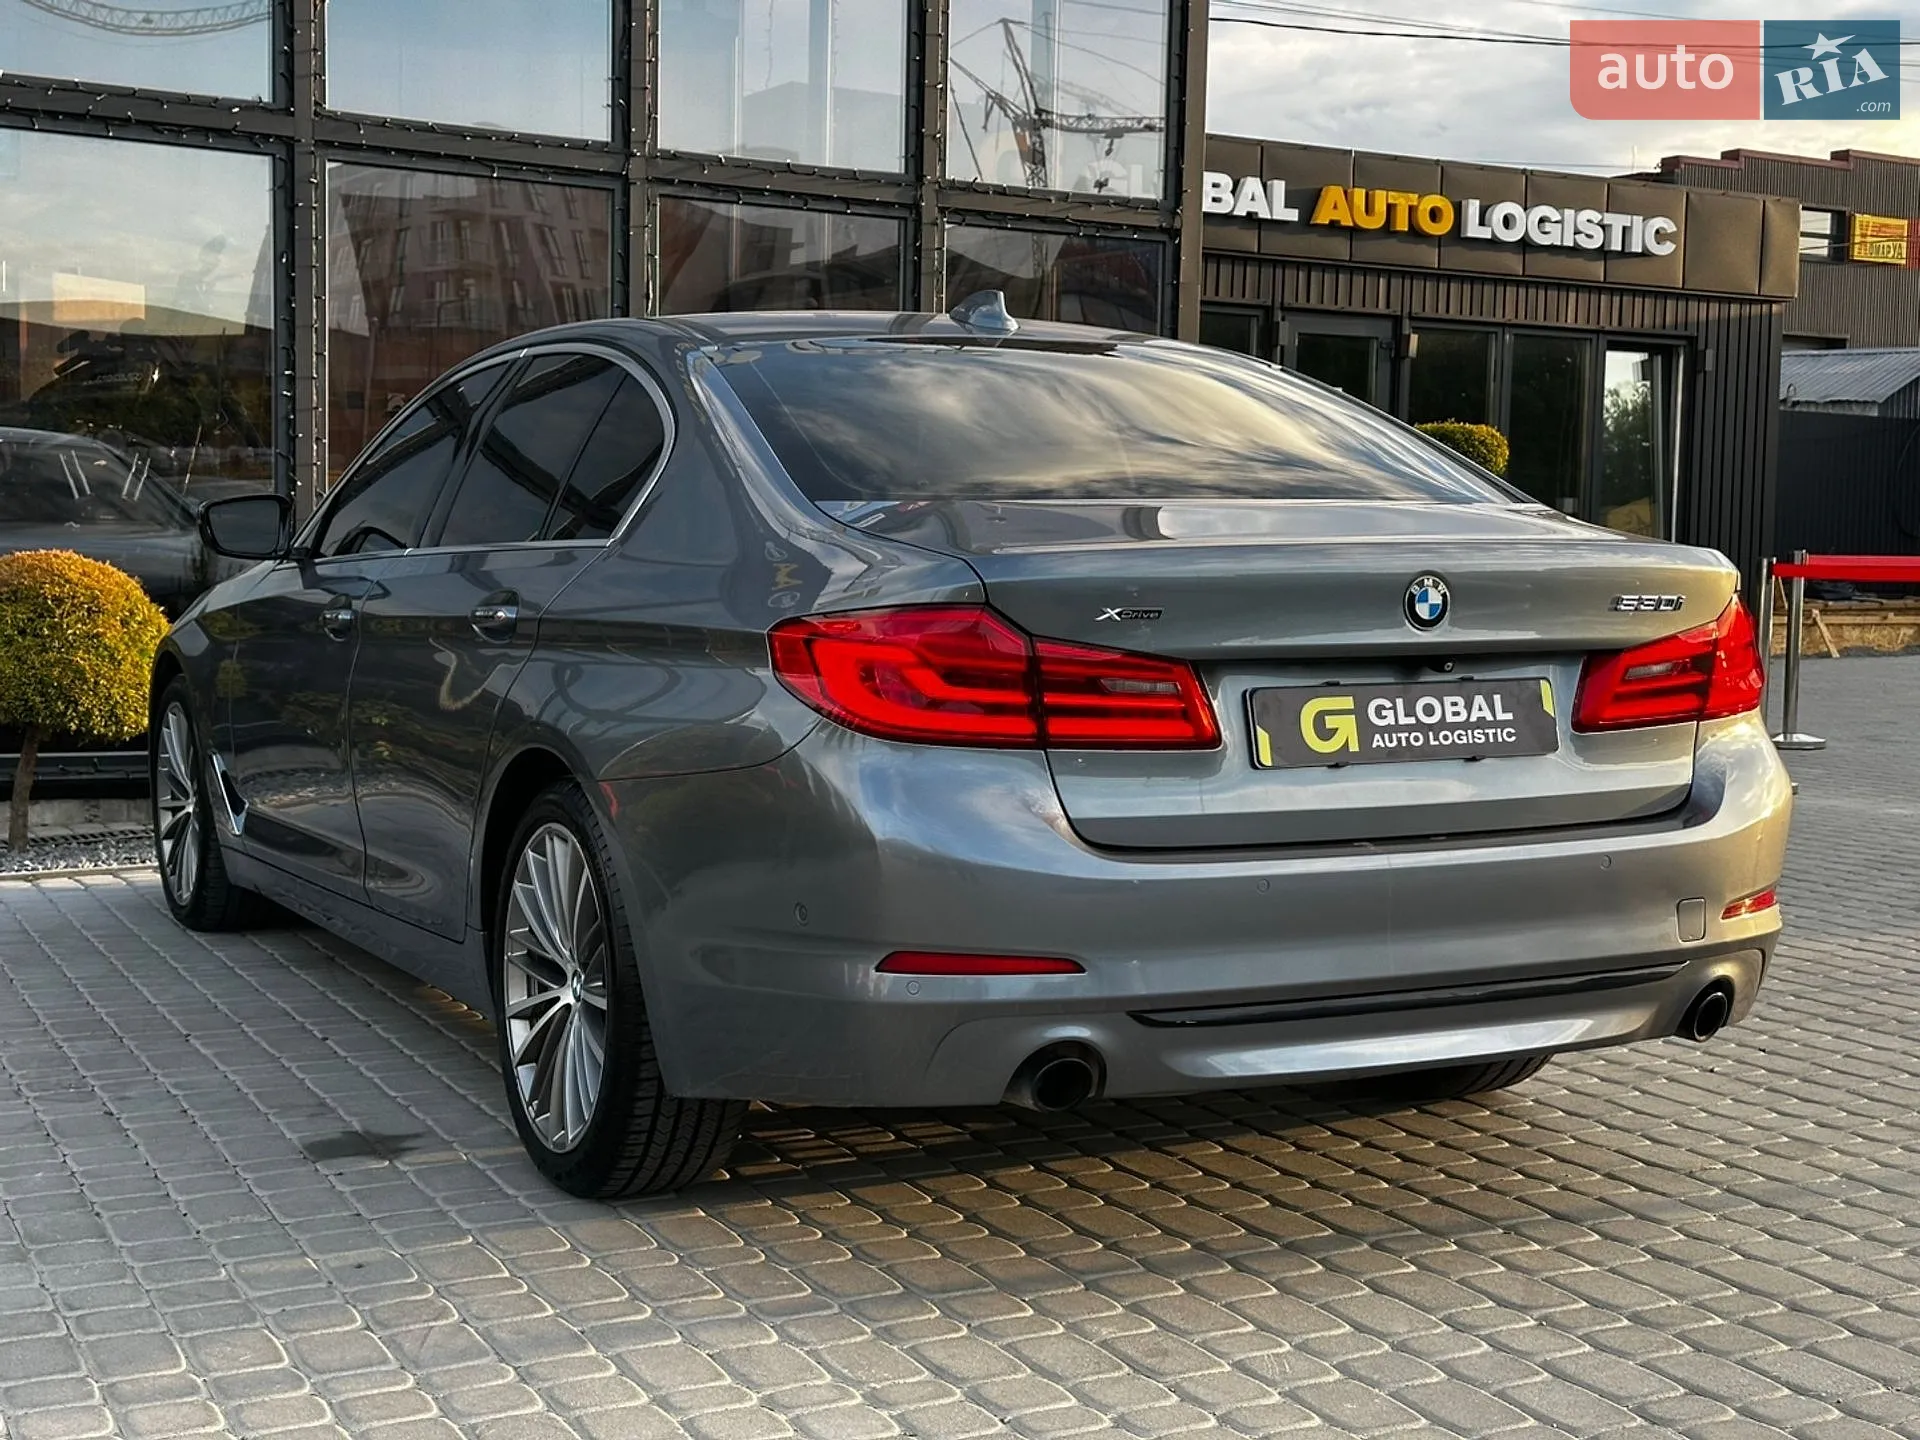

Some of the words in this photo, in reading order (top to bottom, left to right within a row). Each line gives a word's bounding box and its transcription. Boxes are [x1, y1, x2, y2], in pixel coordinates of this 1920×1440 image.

[1310, 185, 1455, 236] AUTO
[1461, 199, 1678, 256] LOGISTIC
[1410, 578, 1447, 595] BMW
[1367, 694, 1514, 727] GLOBAL
[1371, 731, 1424, 748] AUTO
[1429, 728, 1517, 745] LOGISTIC
